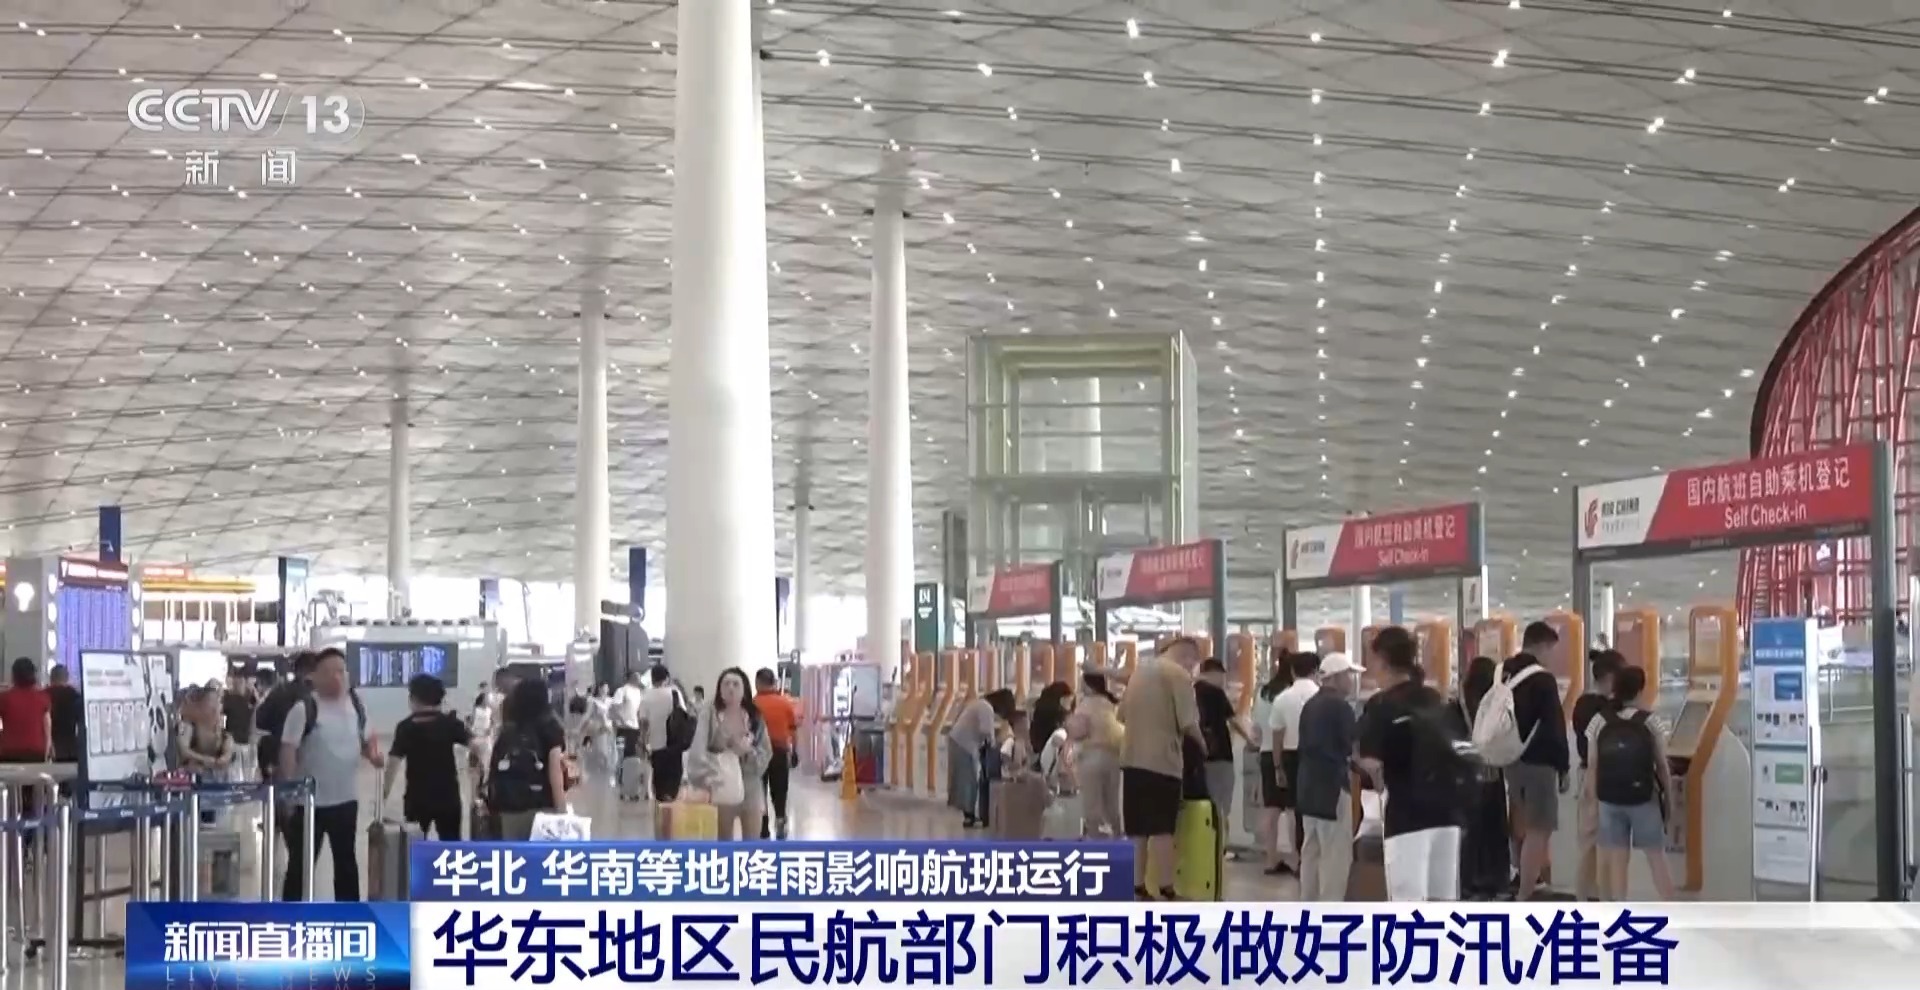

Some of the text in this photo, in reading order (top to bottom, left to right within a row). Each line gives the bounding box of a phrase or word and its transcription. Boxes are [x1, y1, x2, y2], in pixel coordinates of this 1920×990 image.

[1687, 456, 1851, 507] 国内航班自助乘机登记
[1724, 499, 1807, 529] Self Check-in
